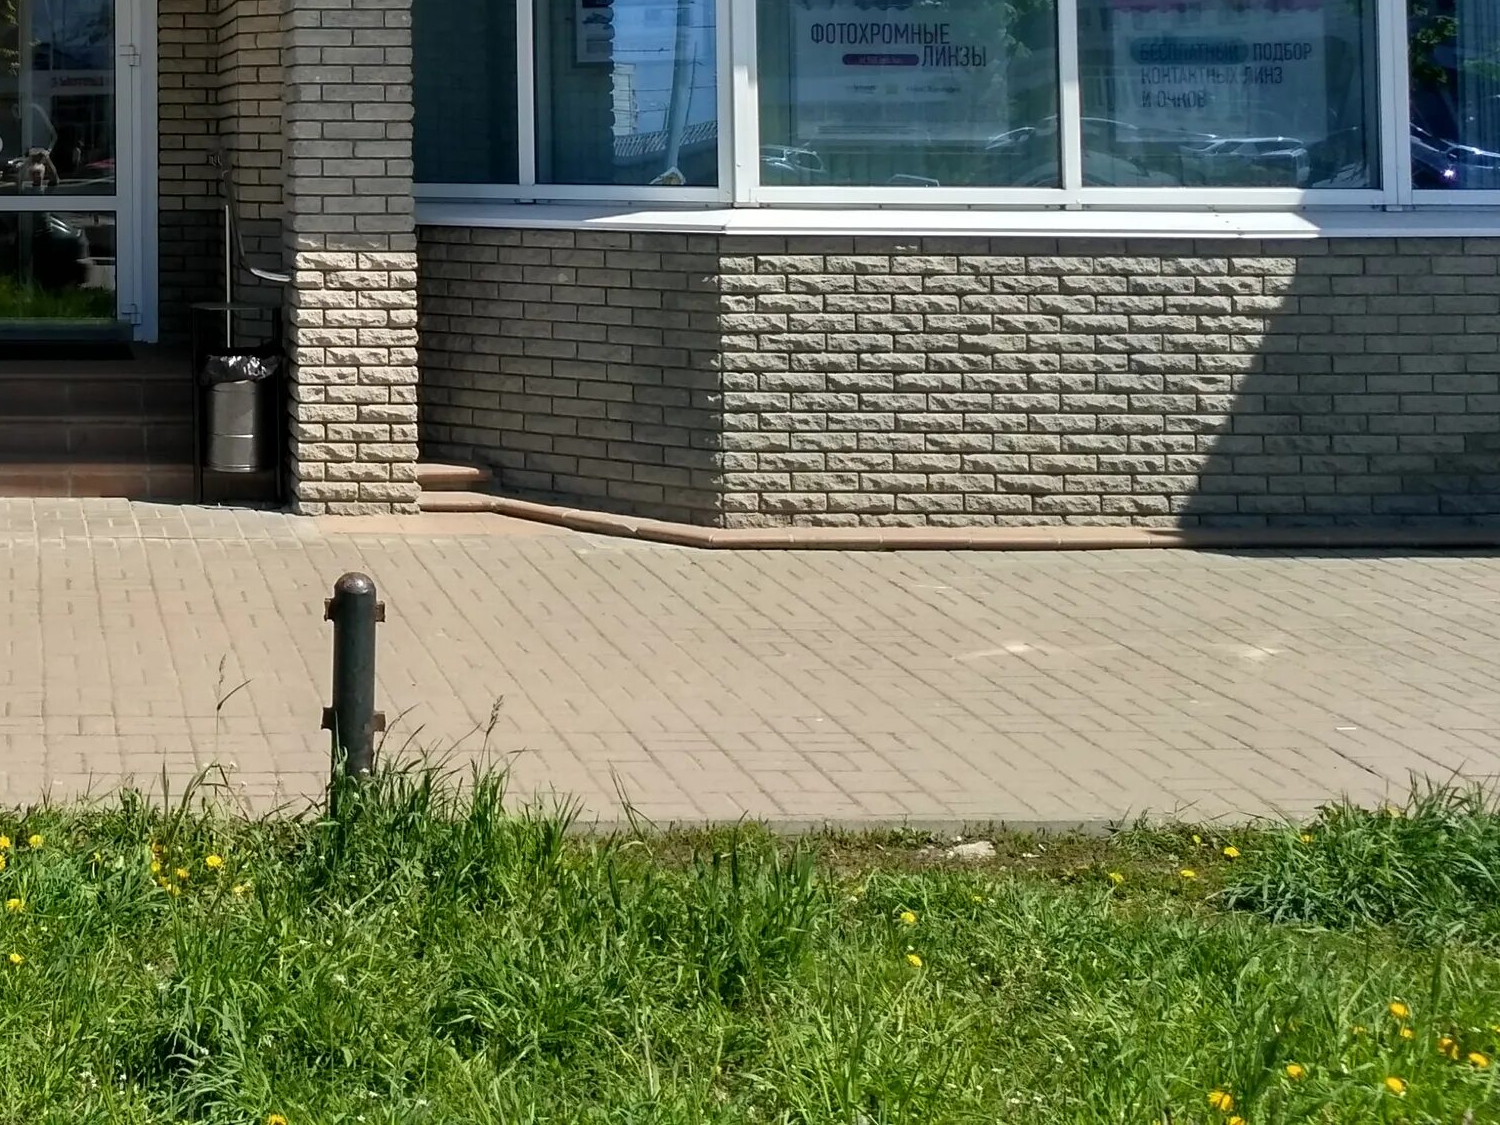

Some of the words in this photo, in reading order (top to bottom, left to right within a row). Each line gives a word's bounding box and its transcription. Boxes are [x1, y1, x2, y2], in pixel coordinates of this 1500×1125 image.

[810, 22, 951, 45] ФОТОХРОМНЫЕ
[921, 45, 987, 68] ЛИНЗЫ
[1252, 42, 1313, 63] ПОДБОР
[1141, 66, 1239, 85] КОНТАКТНЫХ
[1242, 66, 1284, 85] ЛИНЗ
[1142, 89, 1152, 108] И
[1157, 90, 1208, 108] ОЧКОВ
